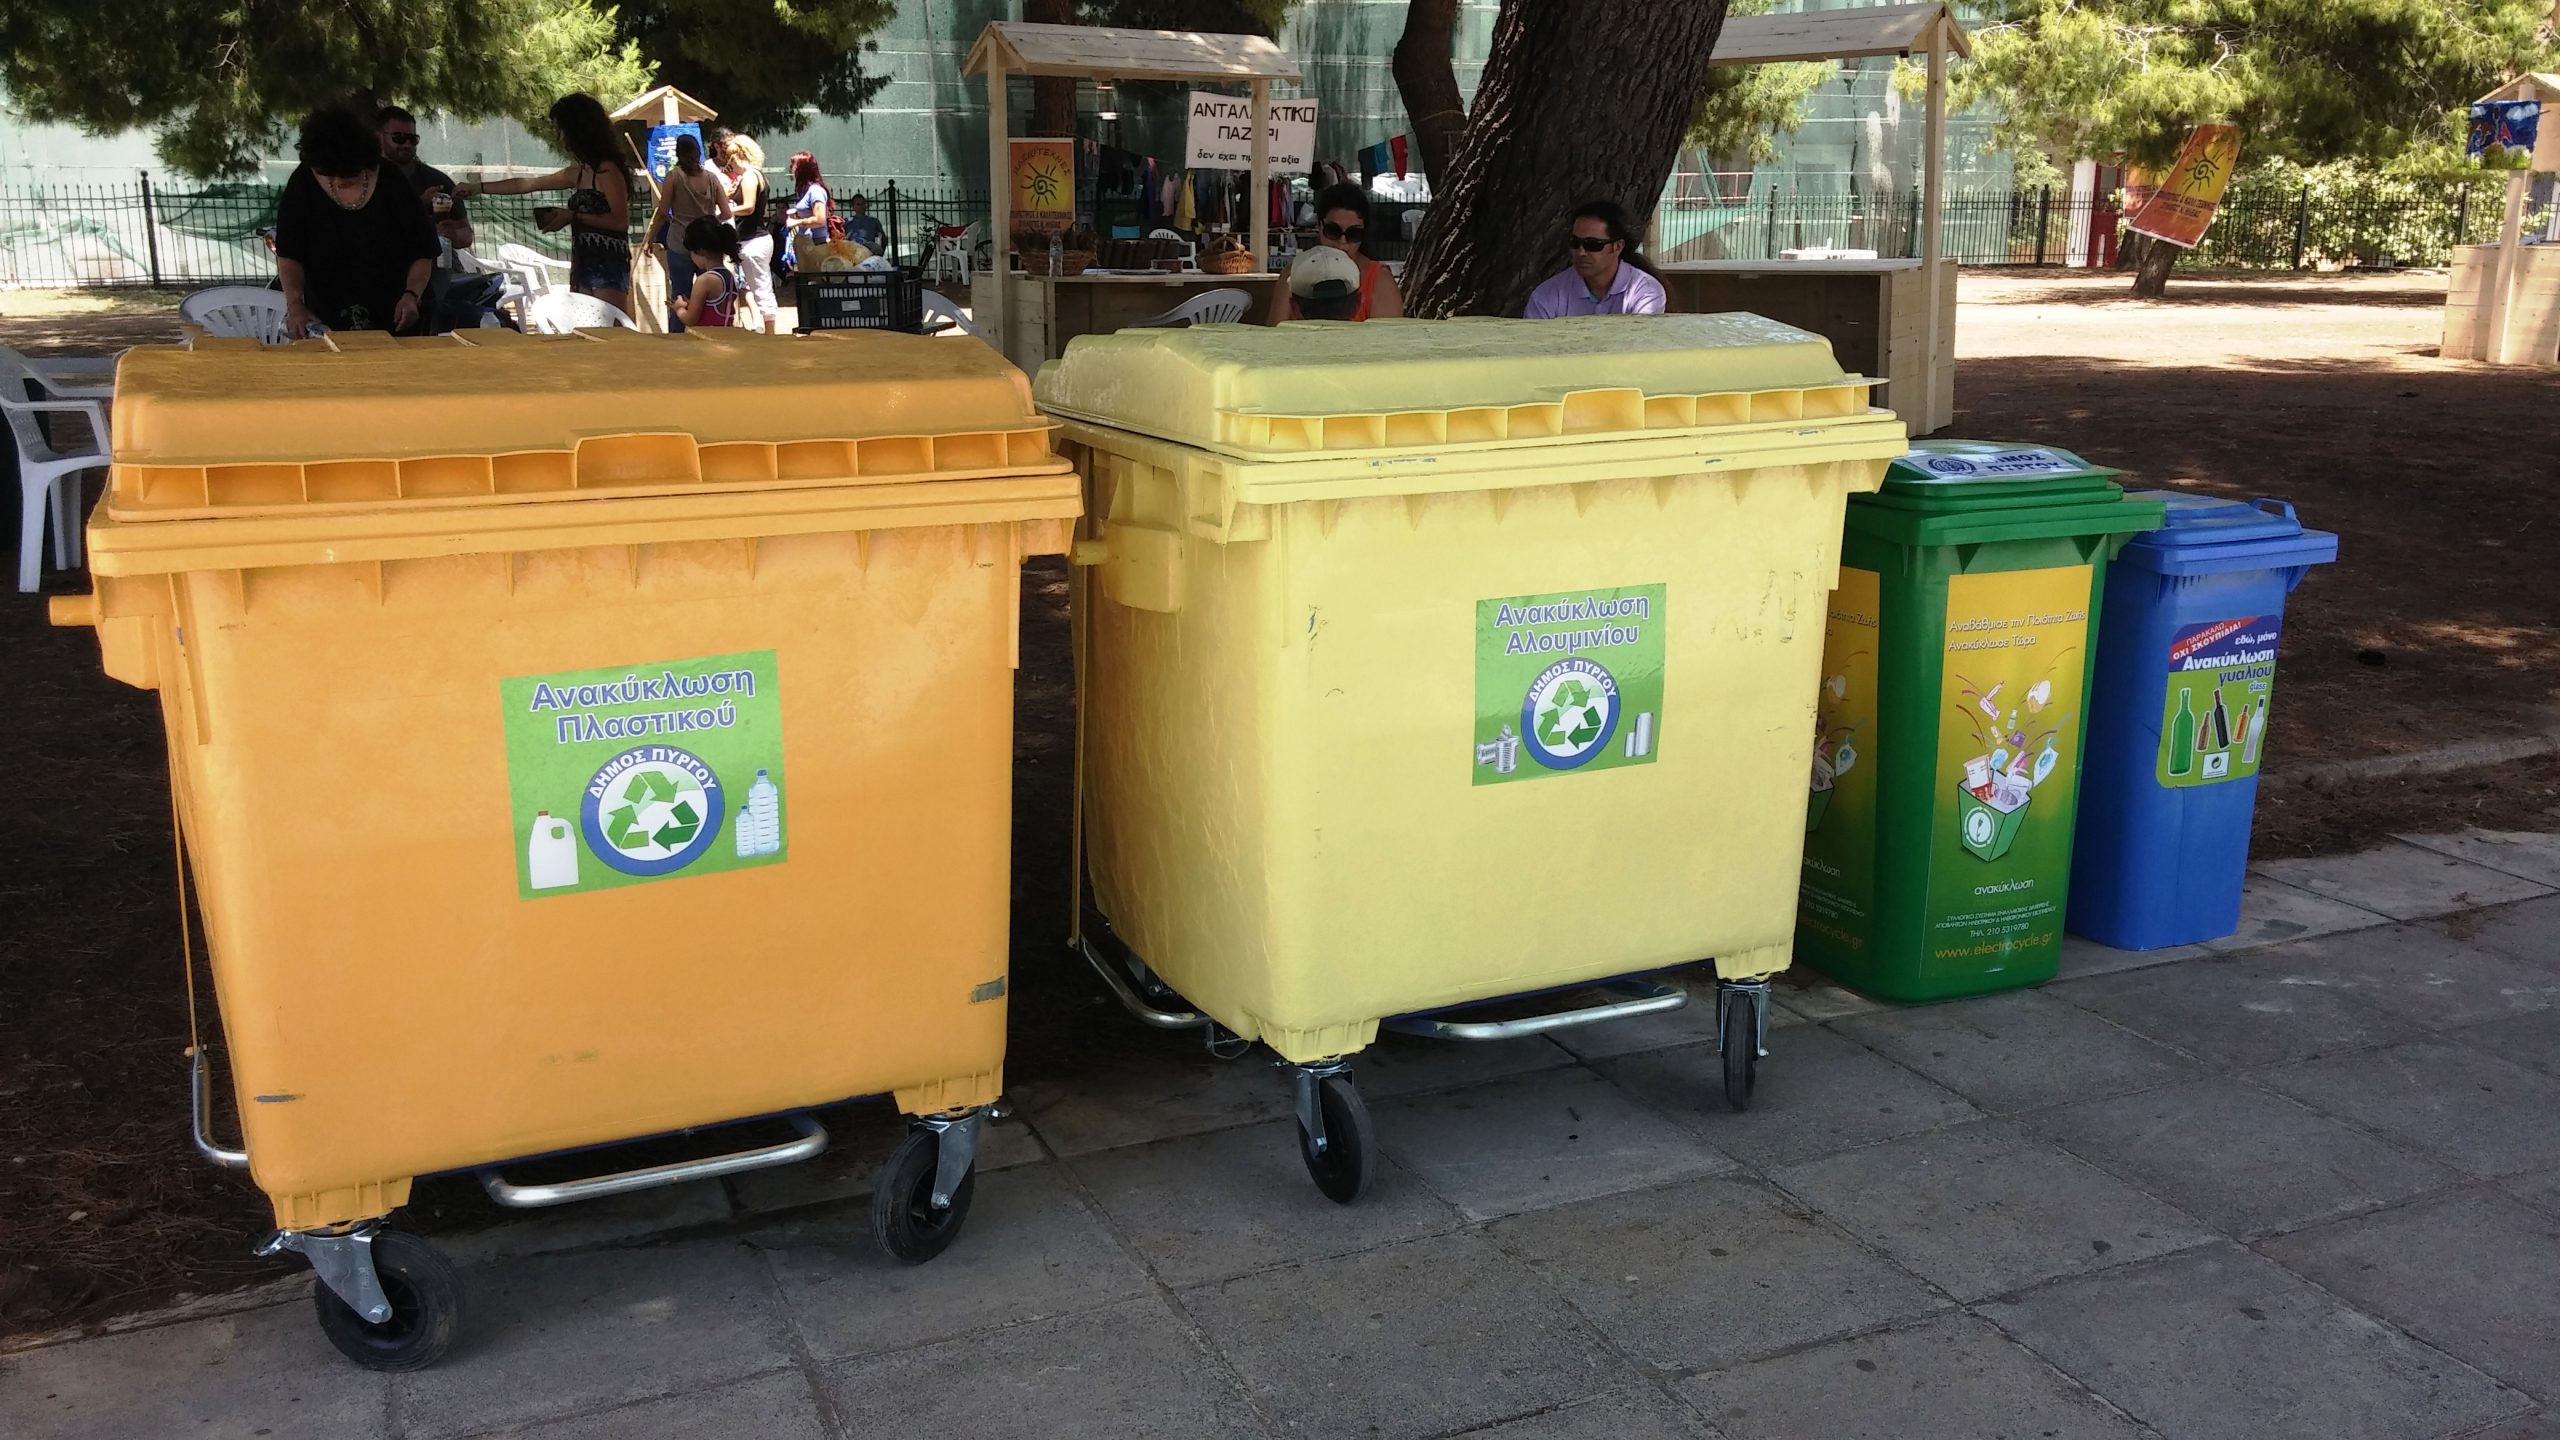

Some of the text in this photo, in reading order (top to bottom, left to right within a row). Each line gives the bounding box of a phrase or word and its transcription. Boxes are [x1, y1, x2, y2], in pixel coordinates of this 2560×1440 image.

[1193, 102, 1315, 123] ΑΝΤΑΛΚΤΙΚΟ
[1218, 126, 1279, 141] ΠΑΖΡΙ
[1197, 148, 1214, 160] δεν
[1218, 151, 1237, 161] έχει
[1281, 154, 1300, 164] αξία
[1495, 596, 1650, 628] Ανακύκλωση
[1505, 624, 1639, 656] Αλουμινίου
[2172, 621, 2242, 661] ΟΧΙ ΣΚΟΥΠΙΔΙΑ!
[2257, 630, 2277, 644] μόνο
[2182, 648, 2275, 671] Ανακύκλωση
[530, 669, 755, 712] Ανακύκλωση
[1530, 660, 1617, 702] ΔΗΜΟΣ ΠΥΡΓΟΥ
[2248, 681, 2267, 693] glass
[556, 699, 737, 744] Πλαστικού
[589, 748, 717, 799] ΔΗΜΟΣ ΠΥΡΓΟΥ
[1974, 878, 2034, 895] ανακύκλωση
[1986, 927, 2000, 936] 210
[2001, 922, 2030, 934] 5319780
[1935, 932, 2053, 959] www.electrocycle.gr
